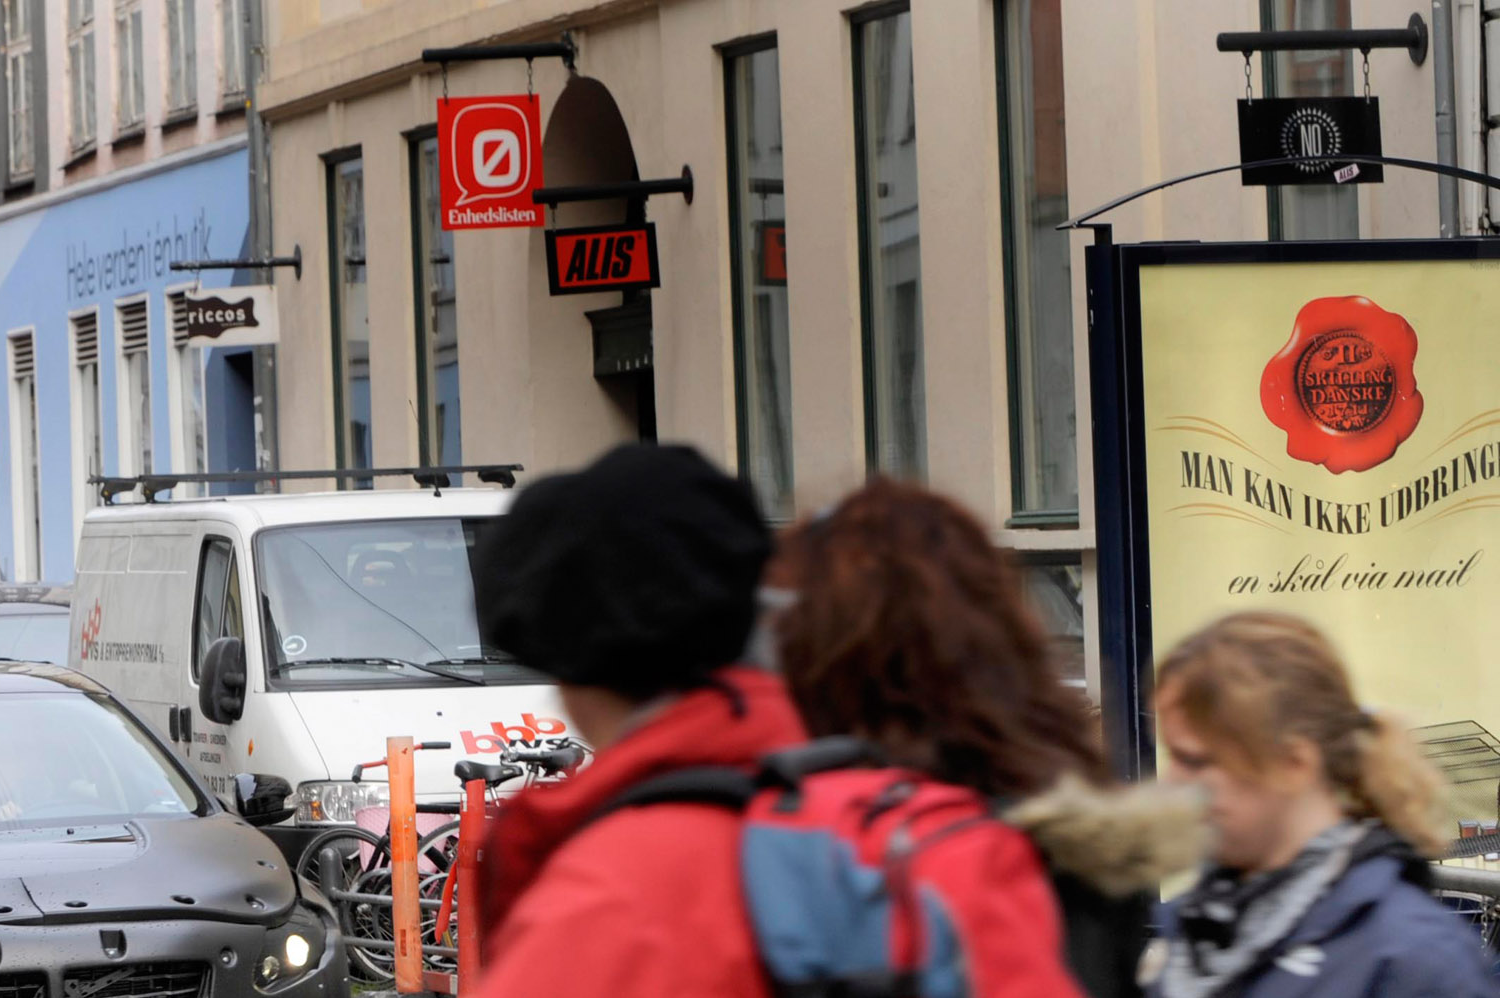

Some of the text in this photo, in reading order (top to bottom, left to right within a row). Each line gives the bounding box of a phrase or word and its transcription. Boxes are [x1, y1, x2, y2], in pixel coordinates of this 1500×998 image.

[1300, 123, 1322, 157] NO
[1339, 167, 1354, 180] ALIS
[449, 206, 536, 224] Enhedslisten
[67, 242, 95, 302] Hele
[97, 227, 147, 292] verden
[565, 235, 635, 283] ALIS
[188, 308, 246, 324] riccos
[1305, 369, 1392, 387] SKILLING
[1312, 386, 1387, 403] DANSKE
[1180, 441, 1500, 535] MAN KAN IKKE UDBRING
[1228, 549, 1485, 595] en skål via mail
[460, 713, 567, 755] bbb
